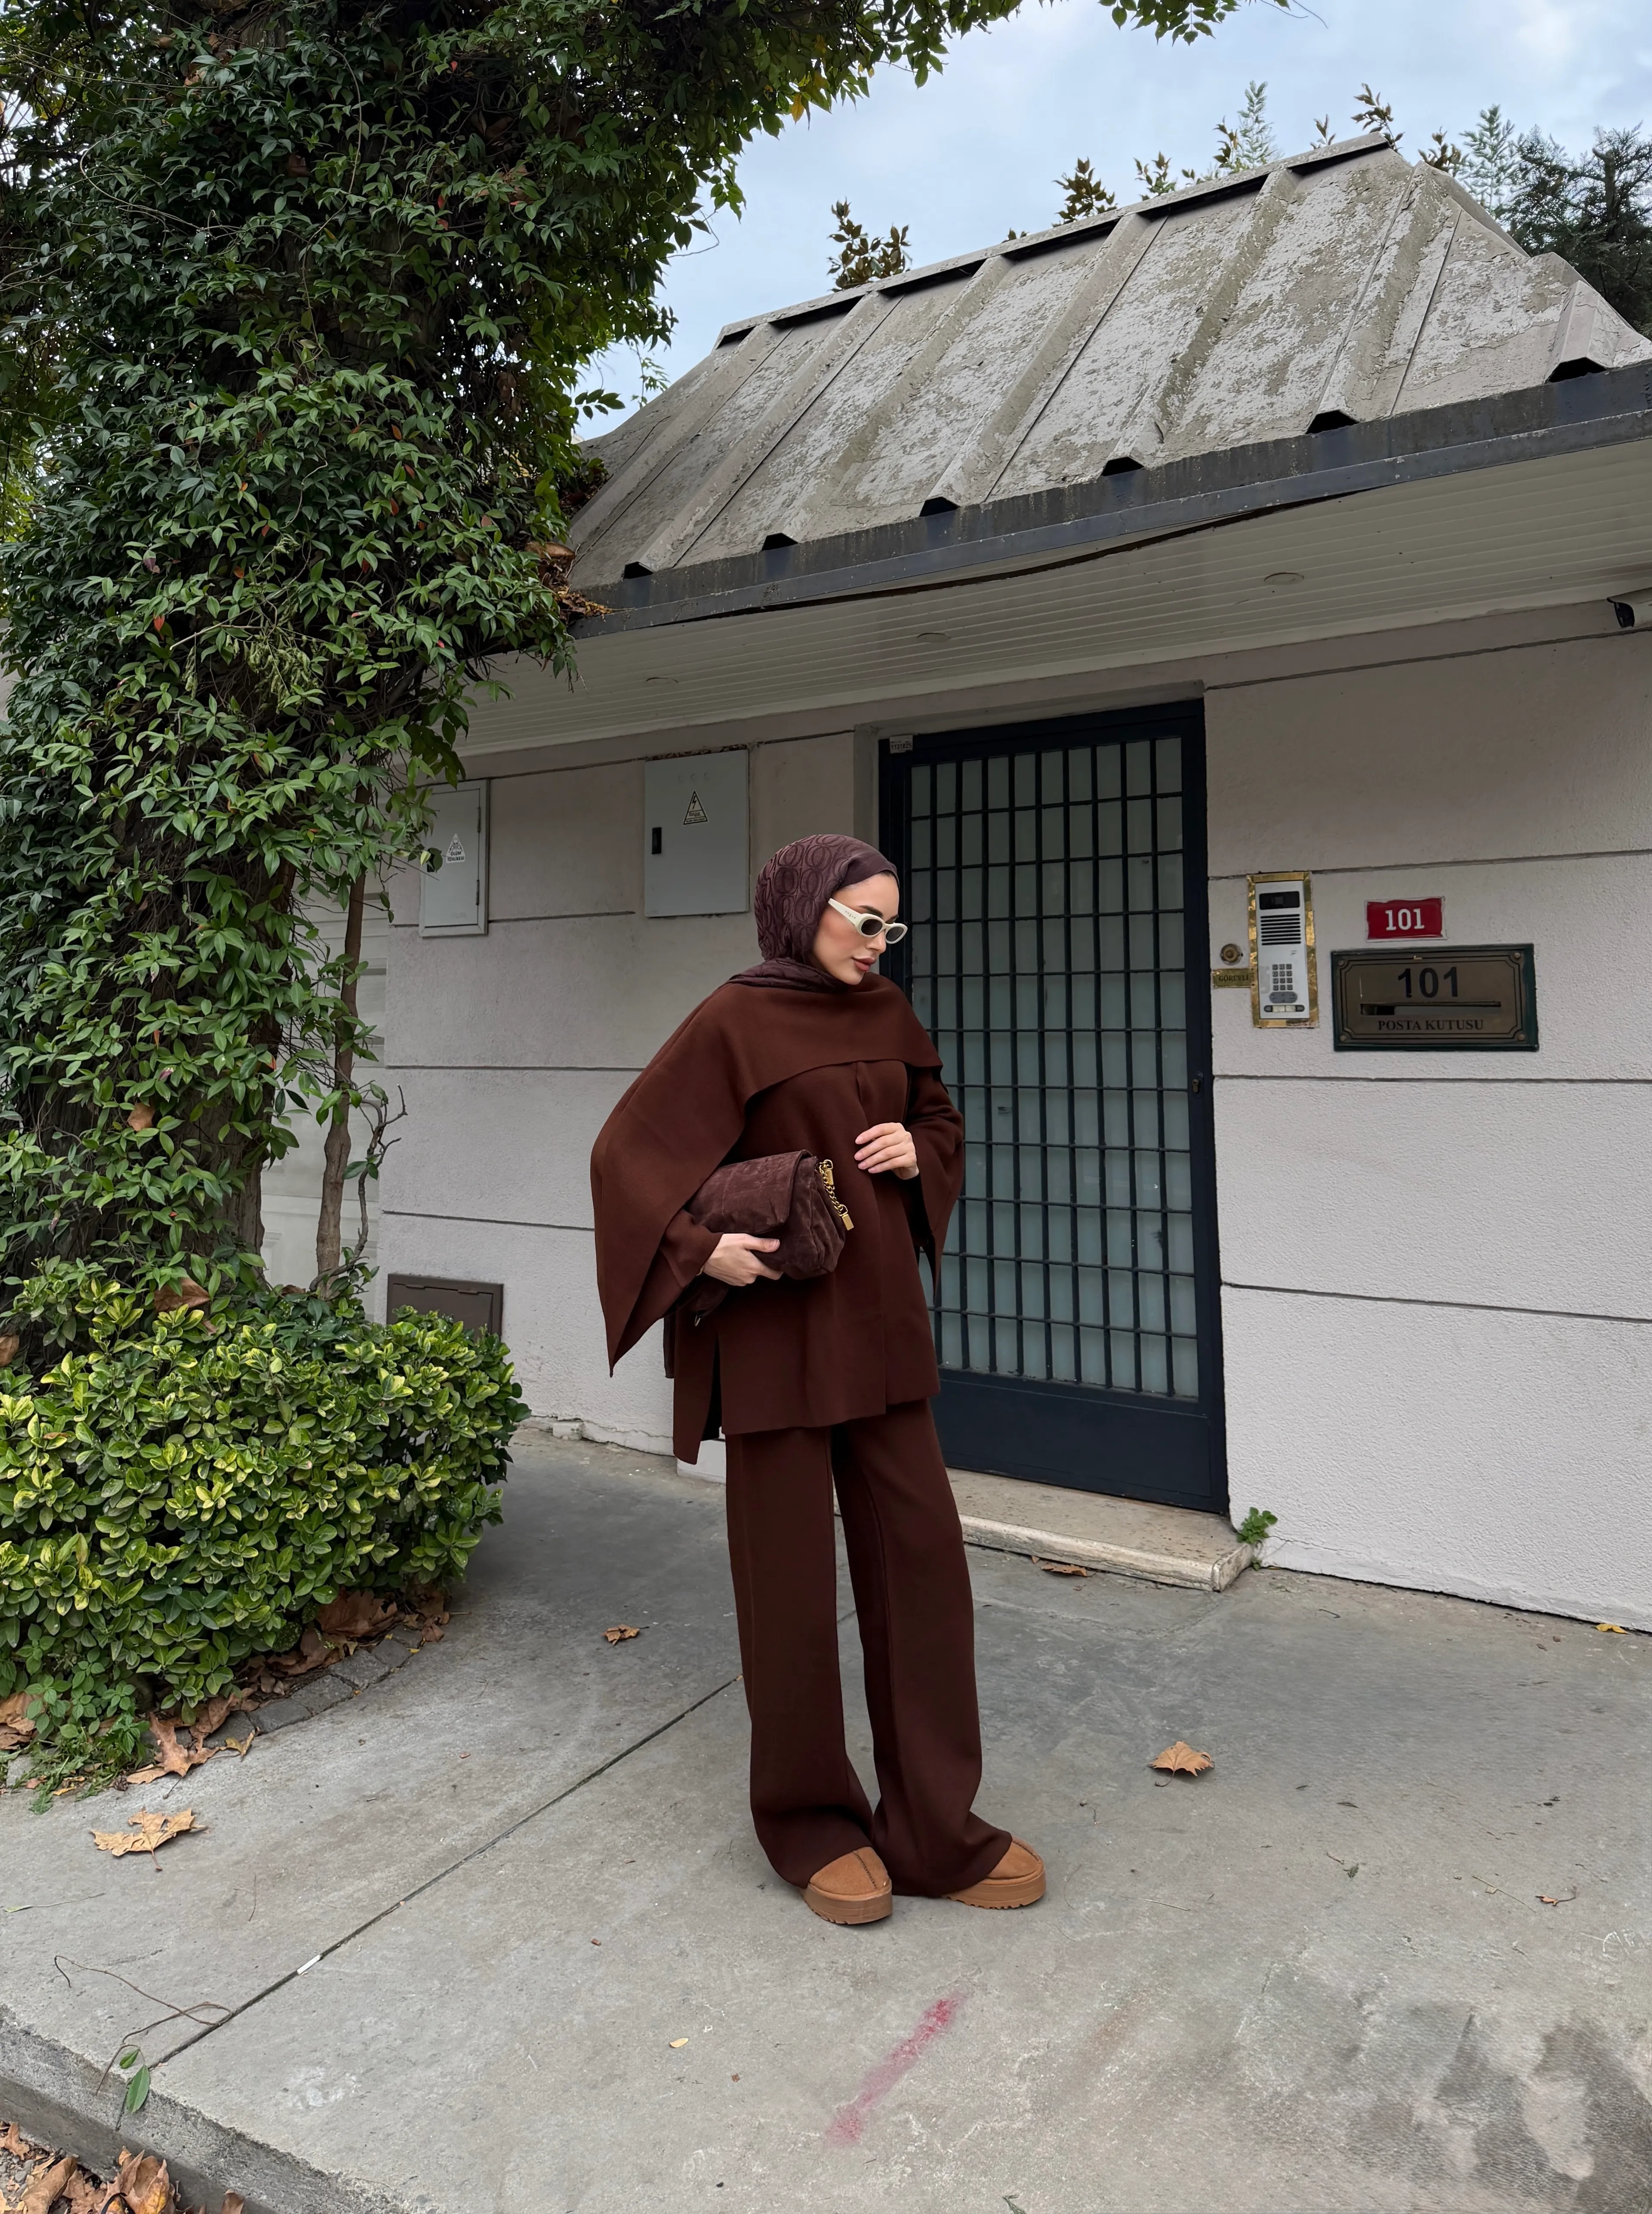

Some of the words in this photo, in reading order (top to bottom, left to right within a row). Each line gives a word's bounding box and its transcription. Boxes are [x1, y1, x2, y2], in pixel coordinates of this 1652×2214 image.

[1385, 908, 1425, 931] 101
[1398, 967, 1458, 998] 101
[1378, 1020, 1421, 1030] POSTA
[1425, 1019, 1483, 1030] KUTUSU
